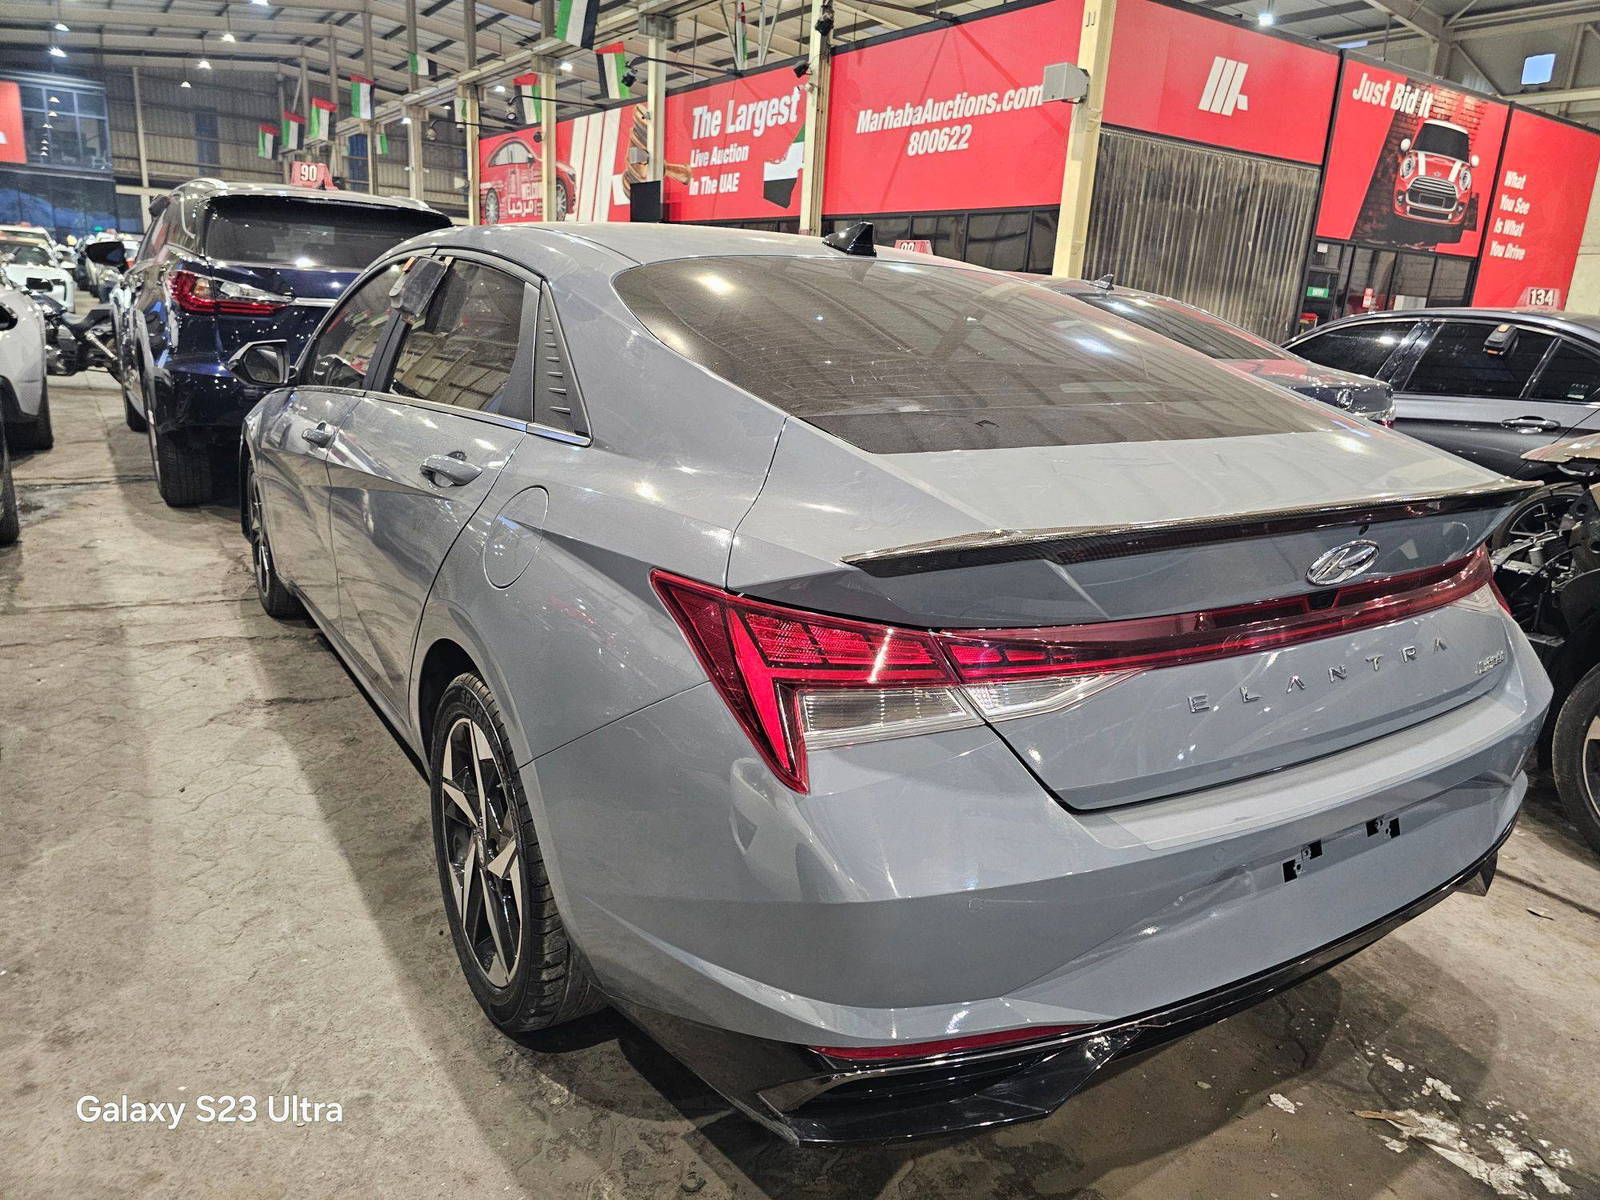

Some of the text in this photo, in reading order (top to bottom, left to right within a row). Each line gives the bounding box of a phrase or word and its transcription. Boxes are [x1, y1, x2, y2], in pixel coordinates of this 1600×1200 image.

[1352, 72, 1434, 118] Just Bid It
[692, 86, 801, 140] The Largest
[856, 84, 1044, 134] MarhabaAuctions.com
[907, 124, 972, 156] 800622
[689, 143, 750, 168] Live Auction
[300, 164, 317, 182] 90
[688, 172, 740, 196] In The UAE
[1504, 170, 1527, 190] What
[1499, 193, 1531, 215] You See
[1493, 216, 1525, 237] Is What
[1489, 240, 1526, 261] You Drive
[1529, 288, 1555, 306] 134
[1186, 637, 1448, 713] ELANTRA
